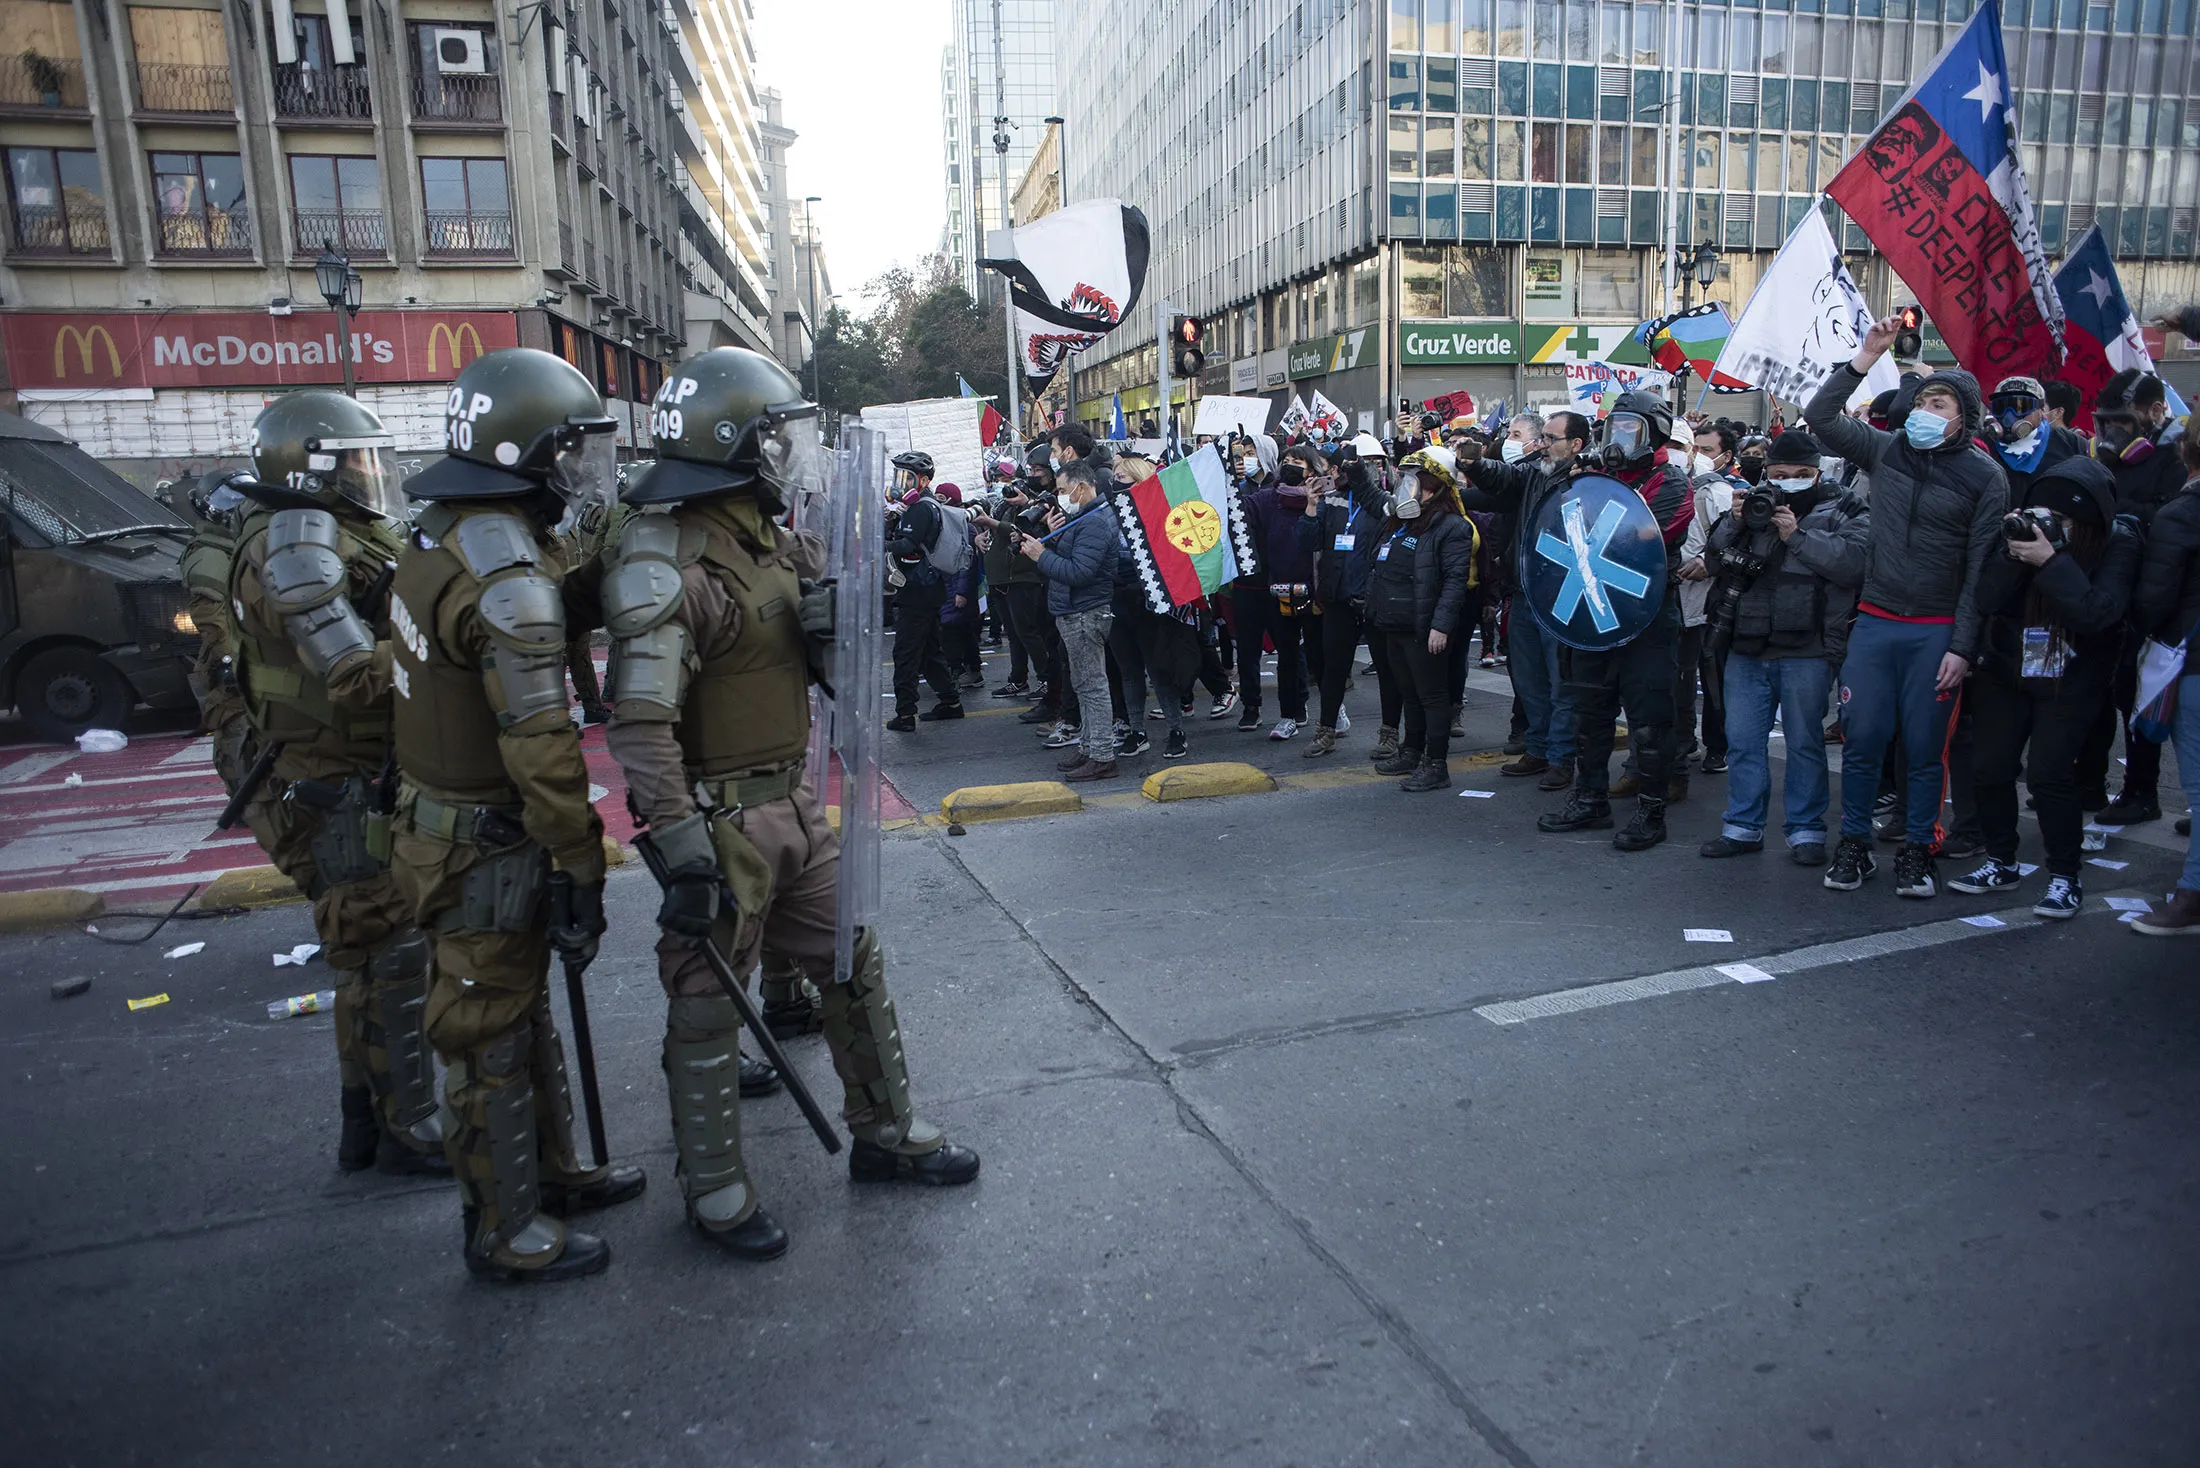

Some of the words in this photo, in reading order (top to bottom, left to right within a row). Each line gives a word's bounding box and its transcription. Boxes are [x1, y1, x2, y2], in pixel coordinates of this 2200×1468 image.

[154, 332, 394, 366] McDonald's
[1406, 332, 1450, 355] Cruz
[1799, 355, 1826, 379] EN
[286, 471, 305, 490] 17
